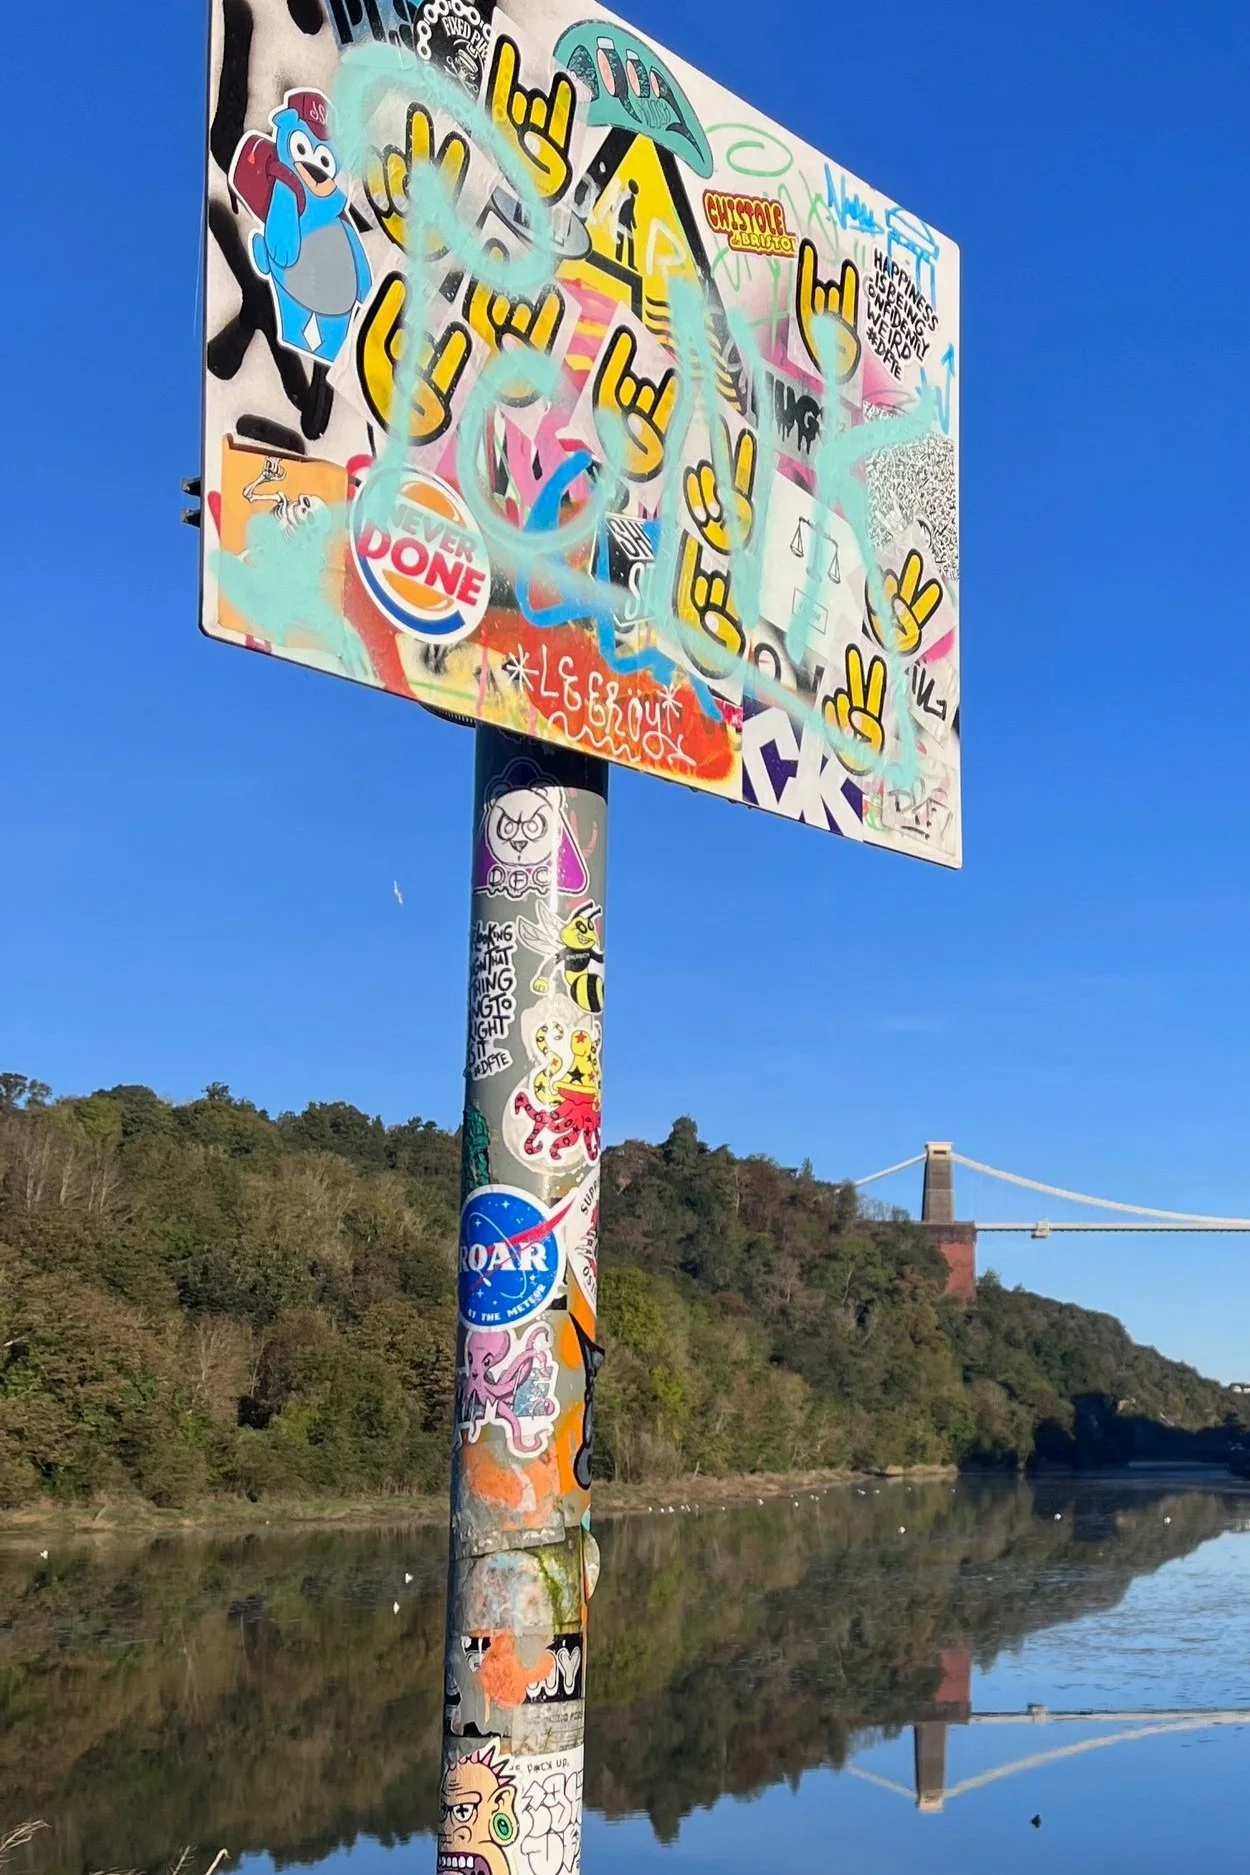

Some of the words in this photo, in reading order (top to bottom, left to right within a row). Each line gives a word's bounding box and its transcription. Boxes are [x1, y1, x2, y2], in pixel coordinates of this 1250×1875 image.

[442, 16, 471, 40] FIXED
[873, 247, 939, 332] HAPPINESS
[875, 270, 887, 294] IS
[886, 280, 927, 337] BEING
[867, 301, 912, 360] WEIRD
[357, 517, 486, 607] DONE
[460, 1241, 549, 1272] ROAR
[481, 1312, 502, 1322] THE
